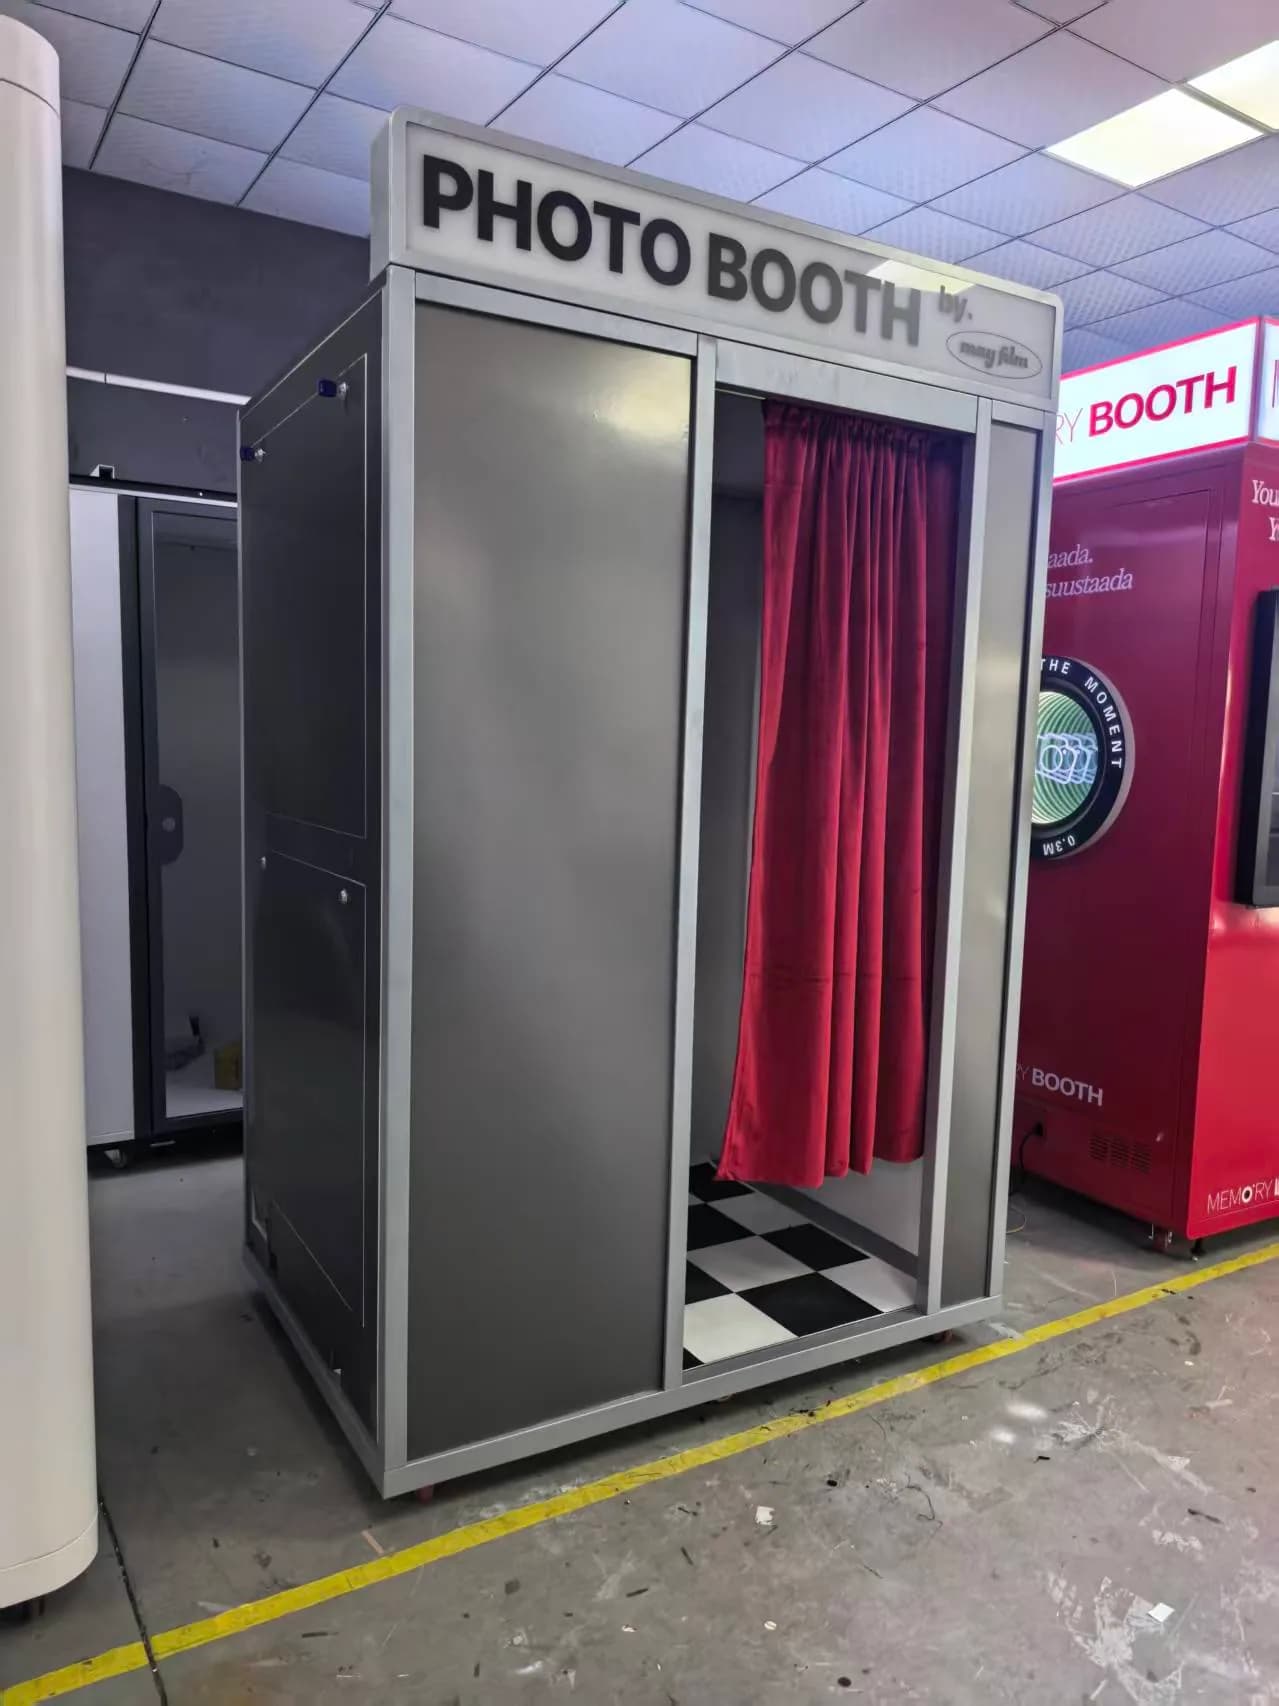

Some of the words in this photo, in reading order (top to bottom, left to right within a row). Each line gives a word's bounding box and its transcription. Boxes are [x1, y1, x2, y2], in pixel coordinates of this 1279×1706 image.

[422, 154, 692, 286] PHOTO
[707, 231, 922, 347] BOOTH
[938, 284, 973, 323] by.
[1089, 365, 1238, 437] BOOTH
[1084, 676, 1123, 769] MOMENT
[1031, 1067, 1104, 1107] BOOTH
[1207, 1179, 1274, 1215] MEMORY
